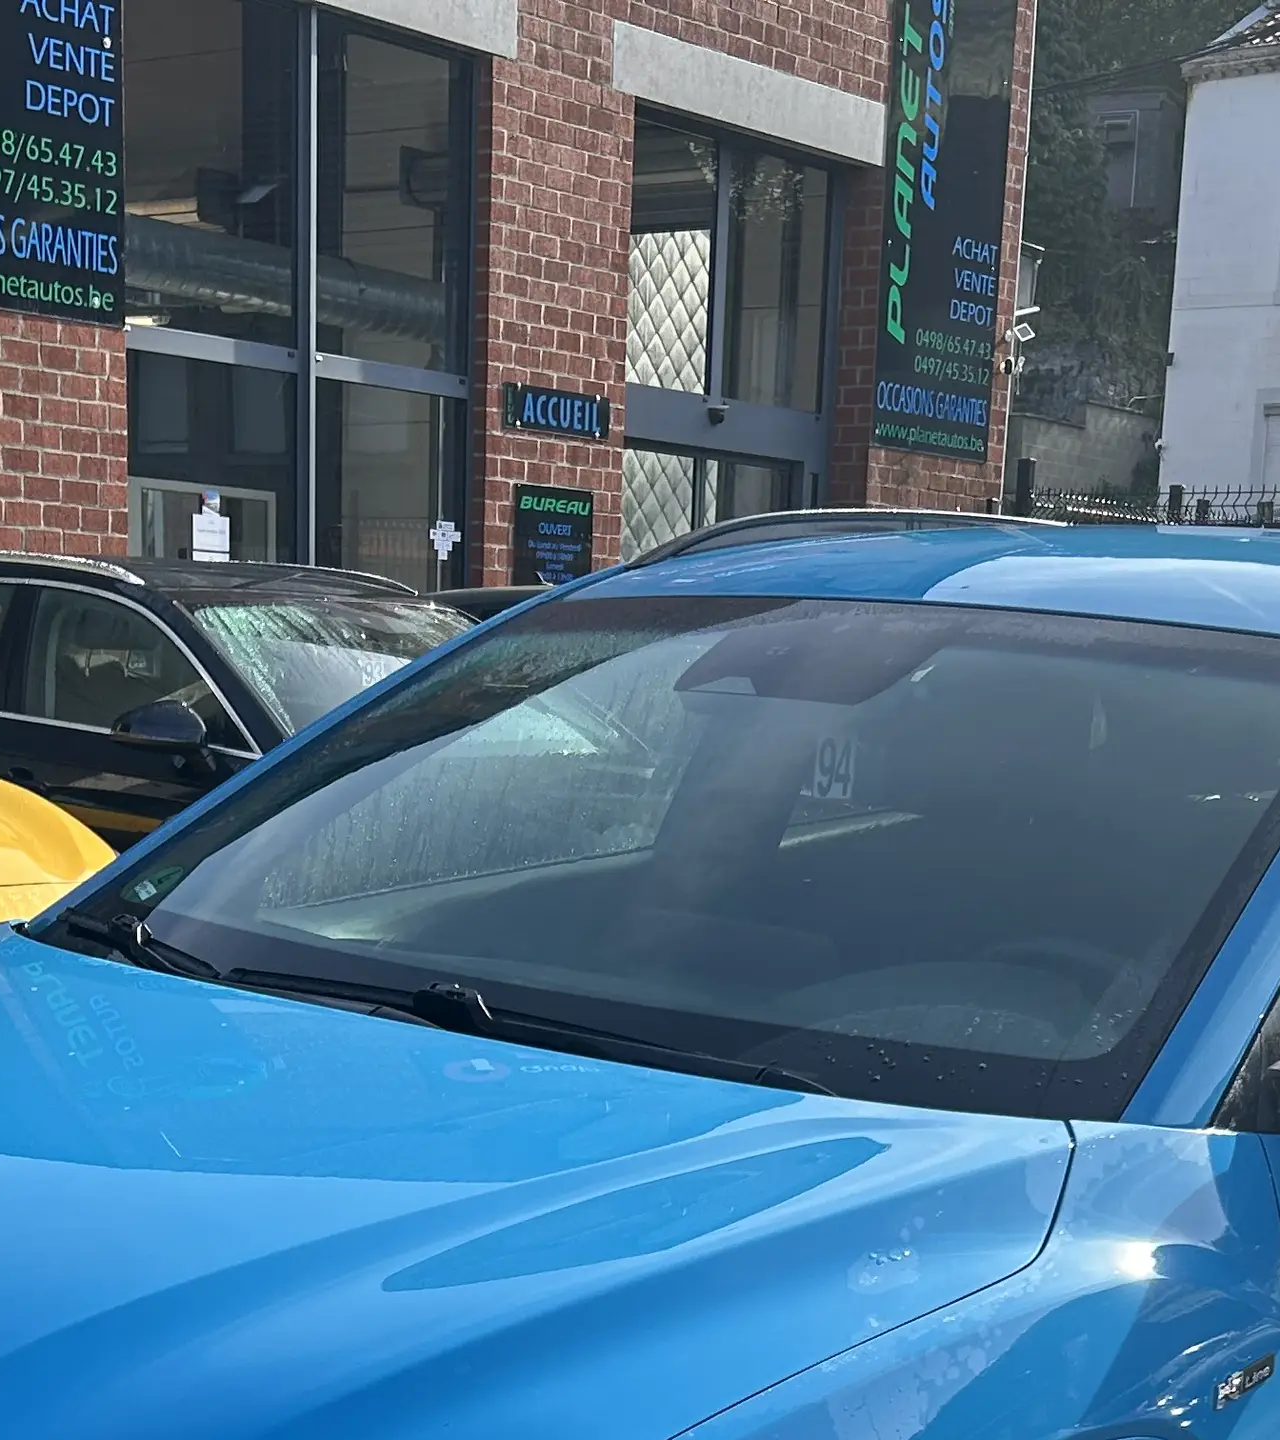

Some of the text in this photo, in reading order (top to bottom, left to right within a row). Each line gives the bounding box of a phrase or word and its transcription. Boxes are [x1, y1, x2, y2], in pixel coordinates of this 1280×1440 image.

[20, 0, 115, 35] ACHAT
[28, 33, 115, 83] VENTE
[25, 79, 115, 127] DEPOT
[887, 3, 923, 344] PLANET
[11, 217, 118, 275] GARANTIES
[953, 236, 998, 265] ACHAT
[955, 268, 996, 297] VENTE
[949, 299, 993, 327] DEPOT
[915, 328, 991, 361] 0498/65.47.43
[914, 355, 989, 386] 0497/45.35.12
[523, 391, 600, 433] ACCUEIL
[877, 381, 987, 427] OCCASIONS GARANTIES
[876, 422, 984, 452] www.planetautos.be
[520, 495, 591, 516] BUREAU
[538, 522, 572, 537] OUVERT
[817, 738, 851, 797] 94
